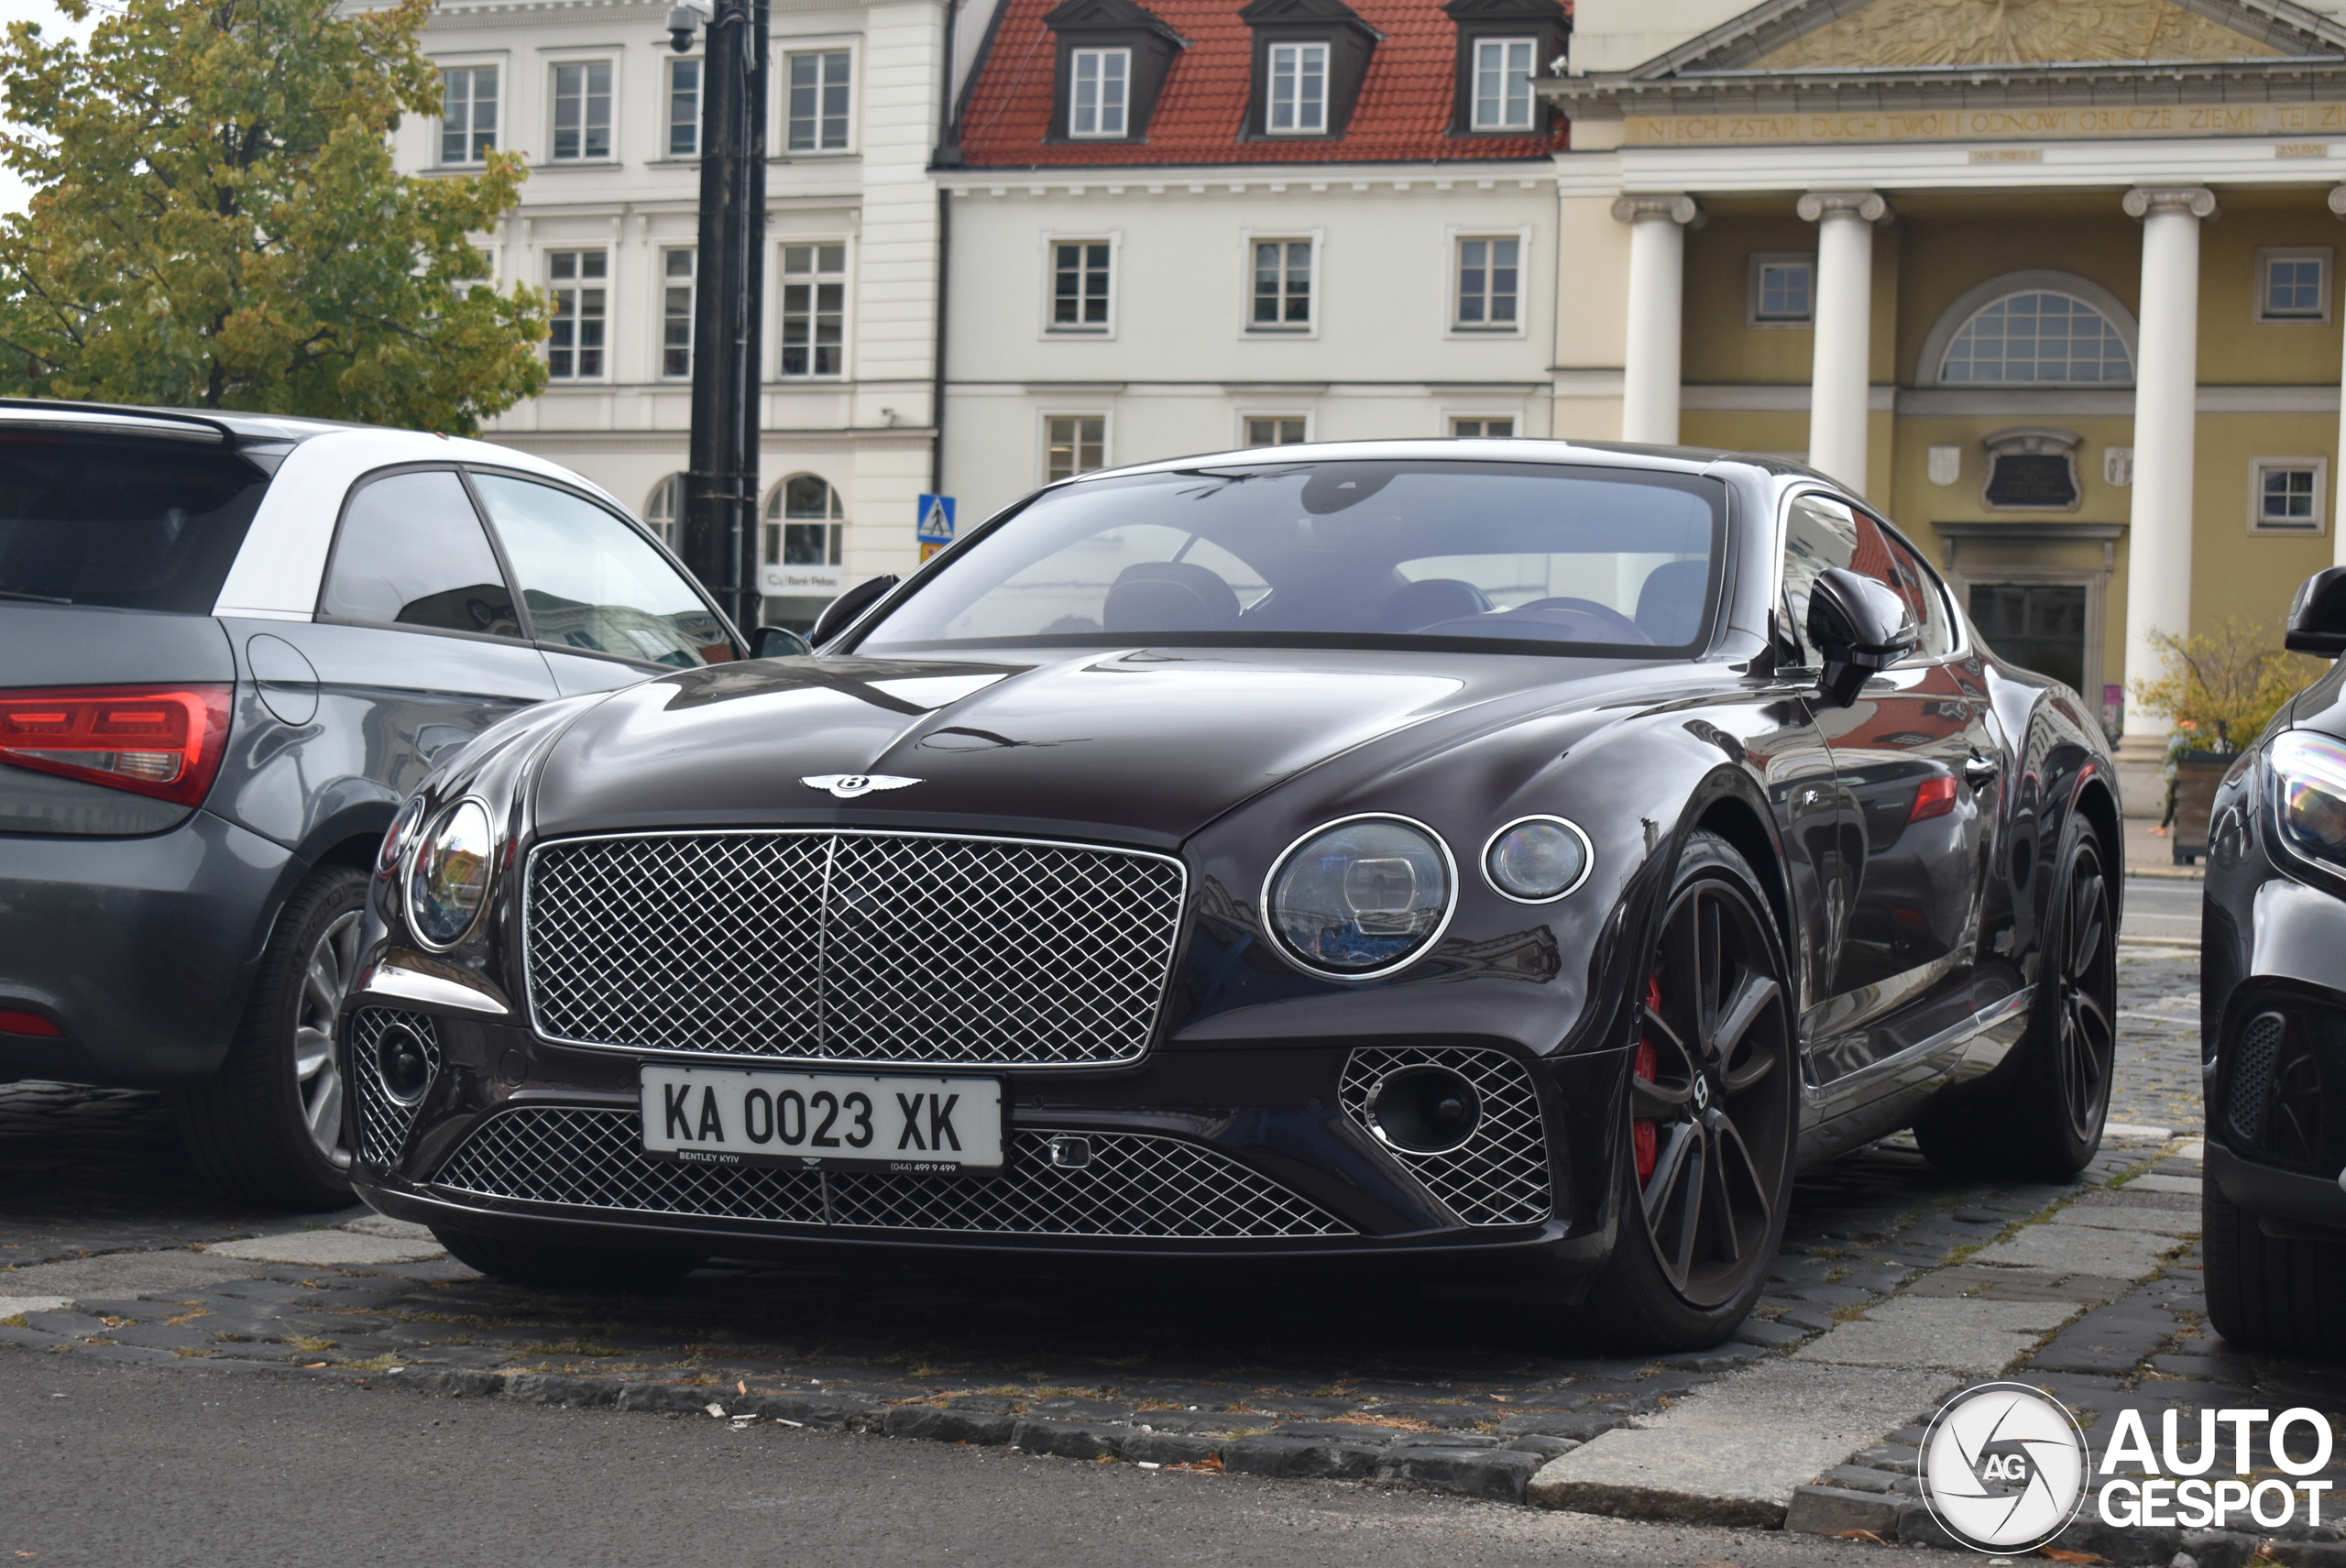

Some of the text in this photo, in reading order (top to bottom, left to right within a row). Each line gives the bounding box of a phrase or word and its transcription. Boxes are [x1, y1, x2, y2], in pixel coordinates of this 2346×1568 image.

[1648, 119, 1720, 138] NIECH
[1812, 116, 1878, 137] DUCH
[1956, 115, 1963, 134] I
[1971, 112, 2069, 133] ODNOWI
[2079, 109, 2172, 131] OBLICZE
[2276, 105, 2308, 129] TEJ
[664, 1083, 962, 1151] KA 0023 XK
[679, 1151, 740, 1163] BENTLEY KYIV
[891, 1162, 957, 1172] (044) 499 9 499
